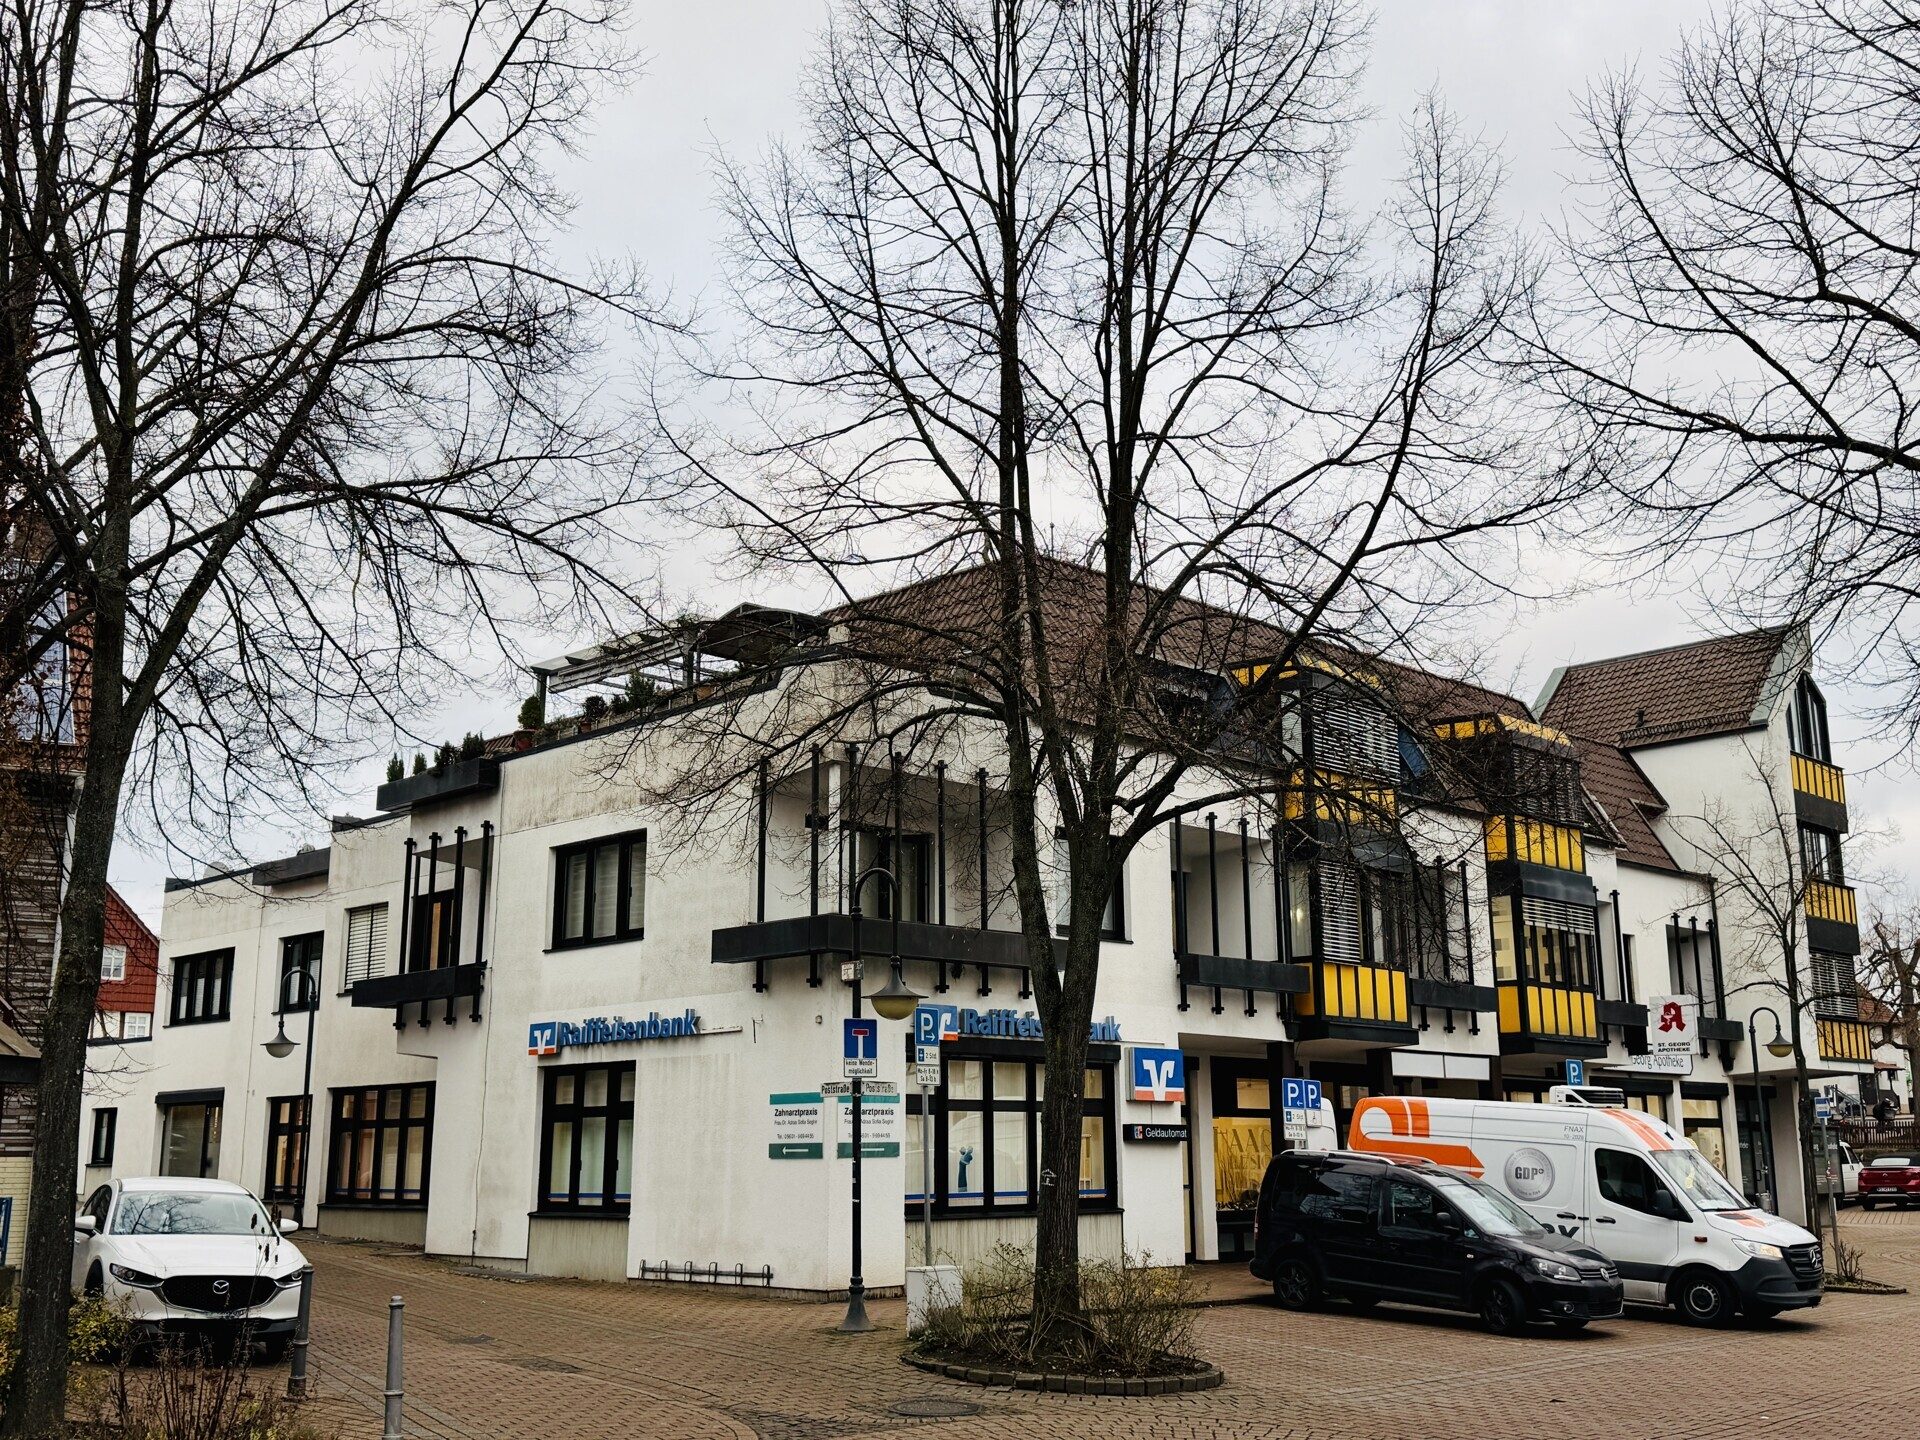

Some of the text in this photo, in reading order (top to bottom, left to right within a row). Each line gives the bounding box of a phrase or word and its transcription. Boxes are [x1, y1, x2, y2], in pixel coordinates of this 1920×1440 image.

[557, 1009, 700, 1047] Raiffeisenbank
[920, 1012, 934, 1041] P
[961, 1008, 1122, 1041] Raiffeisank
[1653, 1055, 1684, 1070] Apotheke
[848, 1068, 873, 1076] möglichkeit
[1570, 1063, 1579, 1083] P
[822, 1084, 850, 1094] Poststraße
[866, 1083, 894, 1094] Possraße
[1287, 1082, 1299, 1107] P
[1307, 1084, 1318, 1108] P
[774, 1108, 818, 1117] Zahnarztpraxis
[844, 1108, 894, 1116] Zaarztpraxis
[1145, 1127, 1187, 1138] Geldautomat
[1563, 1125, 1584, 1133] FNAX
